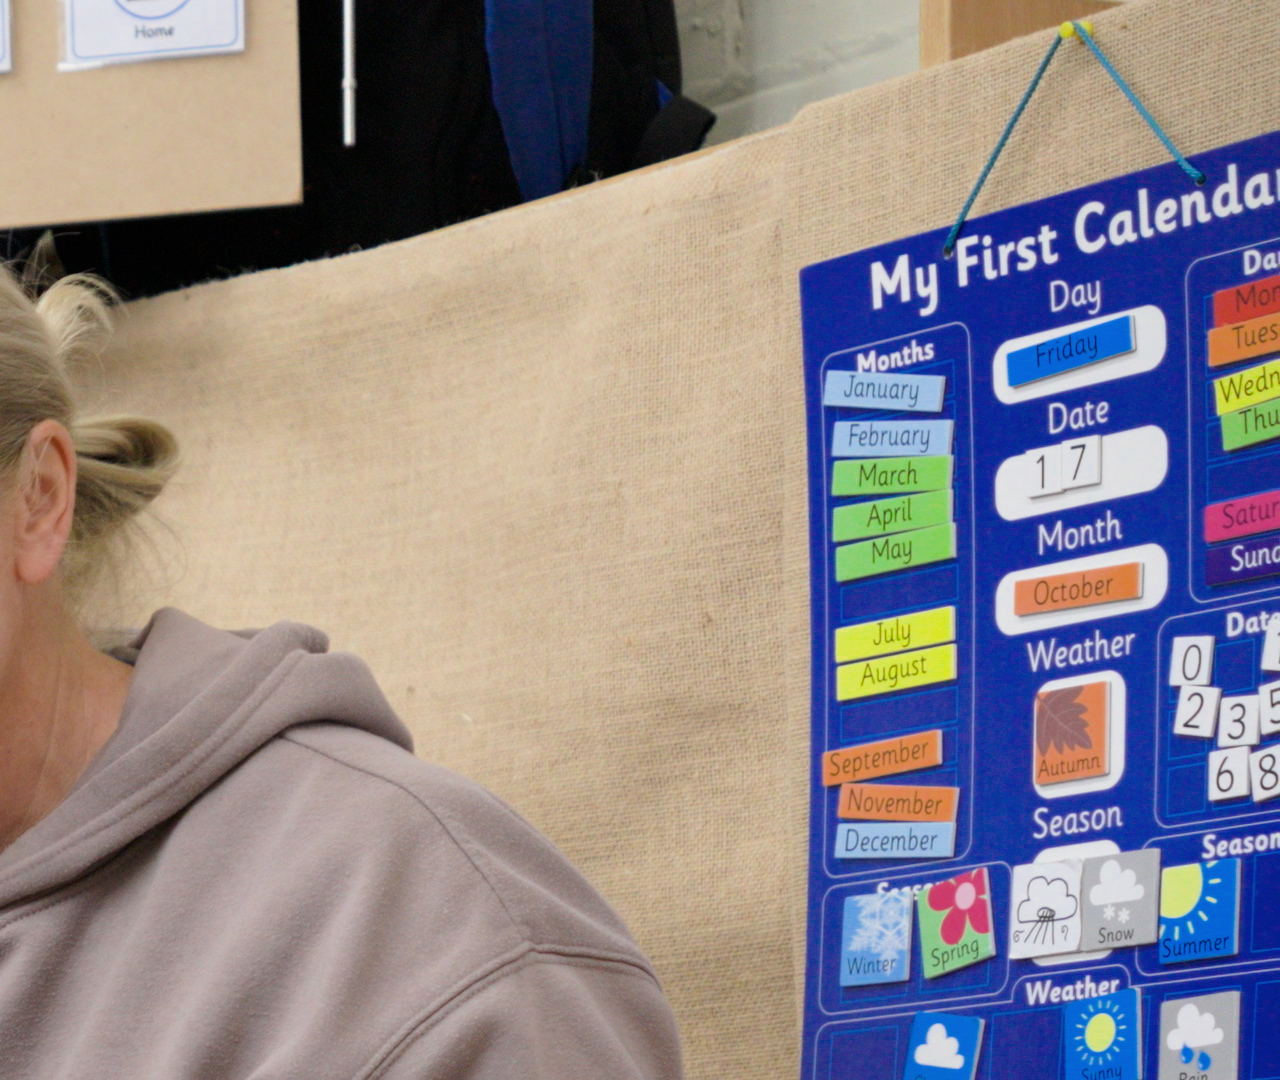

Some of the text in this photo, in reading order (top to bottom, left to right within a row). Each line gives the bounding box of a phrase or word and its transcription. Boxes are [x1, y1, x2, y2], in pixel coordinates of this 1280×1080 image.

[134, 24, 174, 39] Home
[870, 162, 1280, 317] My First Calenda
[1243, 248, 1280, 276] Da
[1049, 280, 1102, 313] Day
[1035, 332, 1100, 370] Friday
[1231, 322, 1279, 349] Tues
[856, 339, 935, 374] Months
[843, 374, 920, 409] January
[1048, 400, 1110, 435] Date
[847, 423, 931, 455] February
[858, 462, 918, 488] March
[866, 495, 913, 531] April
[1038, 511, 1123, 555] Month
[871, 538, 914, 565] May
[1033, 574, 1114, 606] October
[872, 620, 912, 650] July
[1026, 630, 1136, 673] Weather
[860, 656, 928, 690] August
[1181, 644, 1203, 682] 0
[1182, 691, 1205, 730] 2
[1226, 702, 1247, 741] 3
[828, 740, 930, 779] September
[1038, 751, 1102, 779] Autumn
[1215, 755, 1235, 793] 6
[1258, 753, 1279, 791] 8
[847, 788, 944, 817] November
[1033, 805, 1124, 841] Season
[844, 827, 938, 854] December
[1097, 926, 1135, 944] Snow
[1161, 935, 1230, 959] Summer
[846, 955, 897, 976] Winter
[930, 938, 980, 971] Spring
[1024, 974, 1121, 1006] Weather
